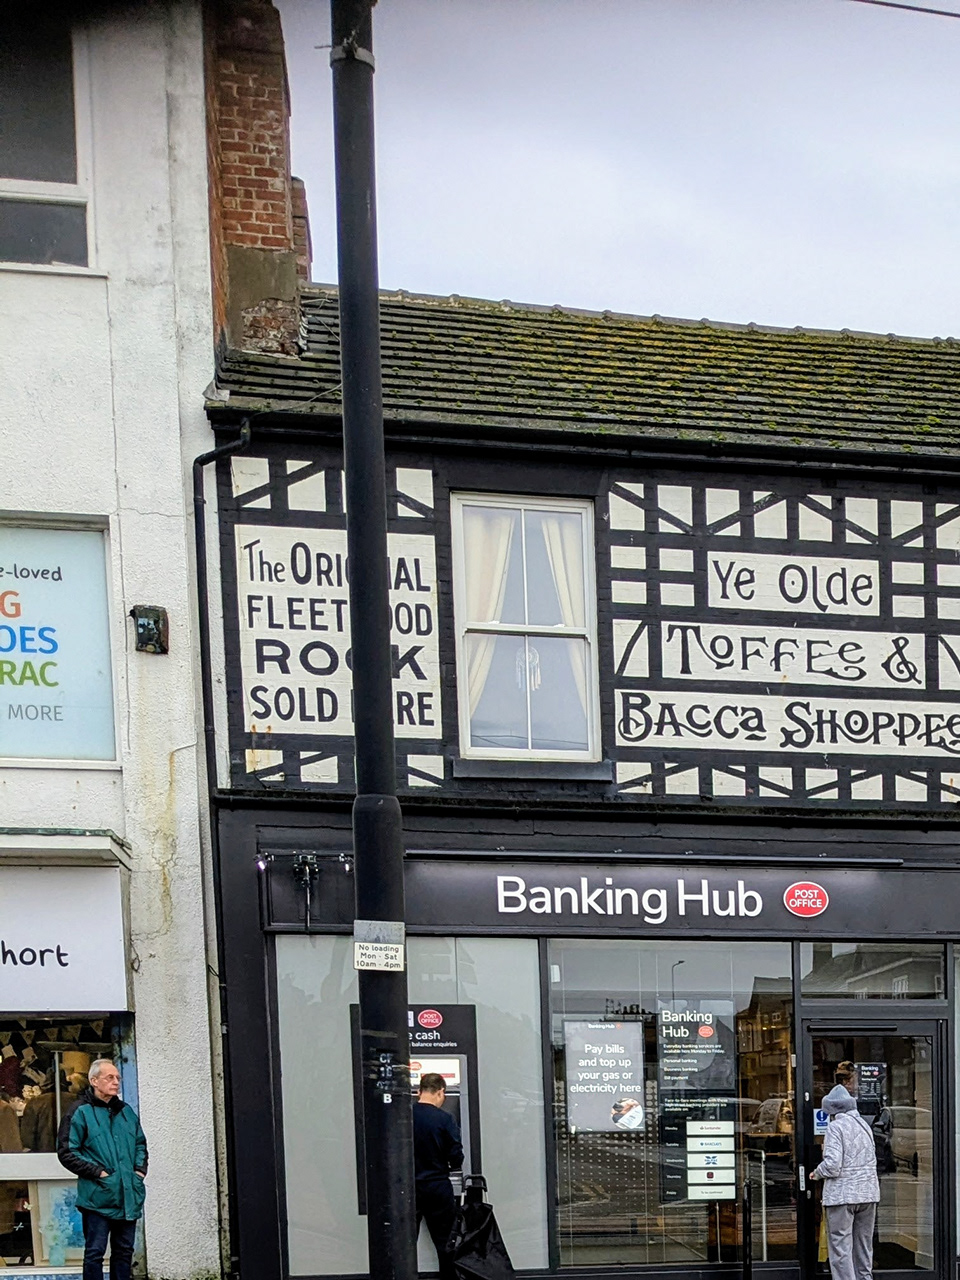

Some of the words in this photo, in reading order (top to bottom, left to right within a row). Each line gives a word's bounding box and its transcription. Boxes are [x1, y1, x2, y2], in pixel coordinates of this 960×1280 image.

[243, 539, 285, 583] The
[290, 541, 431, 593] ORIAL
[712, 559, 755, 602] Ye
[778, 564, 873, 613] Olde
[247, 594, 433, 637] FLEETOD
[256, 638, 428, 681] ROK
[882, 635, 924, 685] &
[249, 685, 339, 723] SOLD
[351, 688, 435, 726] RE
[8, 704, 64, 722] MORE
[496, 875, 667, 924] Banking
[677, 879, 763, 917] Hub
[794, 889, 819, 899] POST
[789, 898, 823, 909] OFFICE
[371, 945, 400, 953] loading
[383, 961, 401, 969] 4pm
[661, 1009, 713, 1025] Banking
[415, 1030, 441, 1040] cash
[662, 1025, 690, 1038] Hub
[584, 1044, 603, 1055] Pay
[605, 1044, 625, 1054] bills
[578, 1057, 597, 1067] and
[600, 1058, 616, 1068] top
[618, 1059, 632, 1068] up
[578, 1072, 600, 1081] your
[602, 1072, 620, 1082] gas
[622, 1072, 633, 1080] or
[570, 1083, 617, 1095] electricity
[619, 1083, 641, 1093] here
[383, 1093, 393, 1104] B
